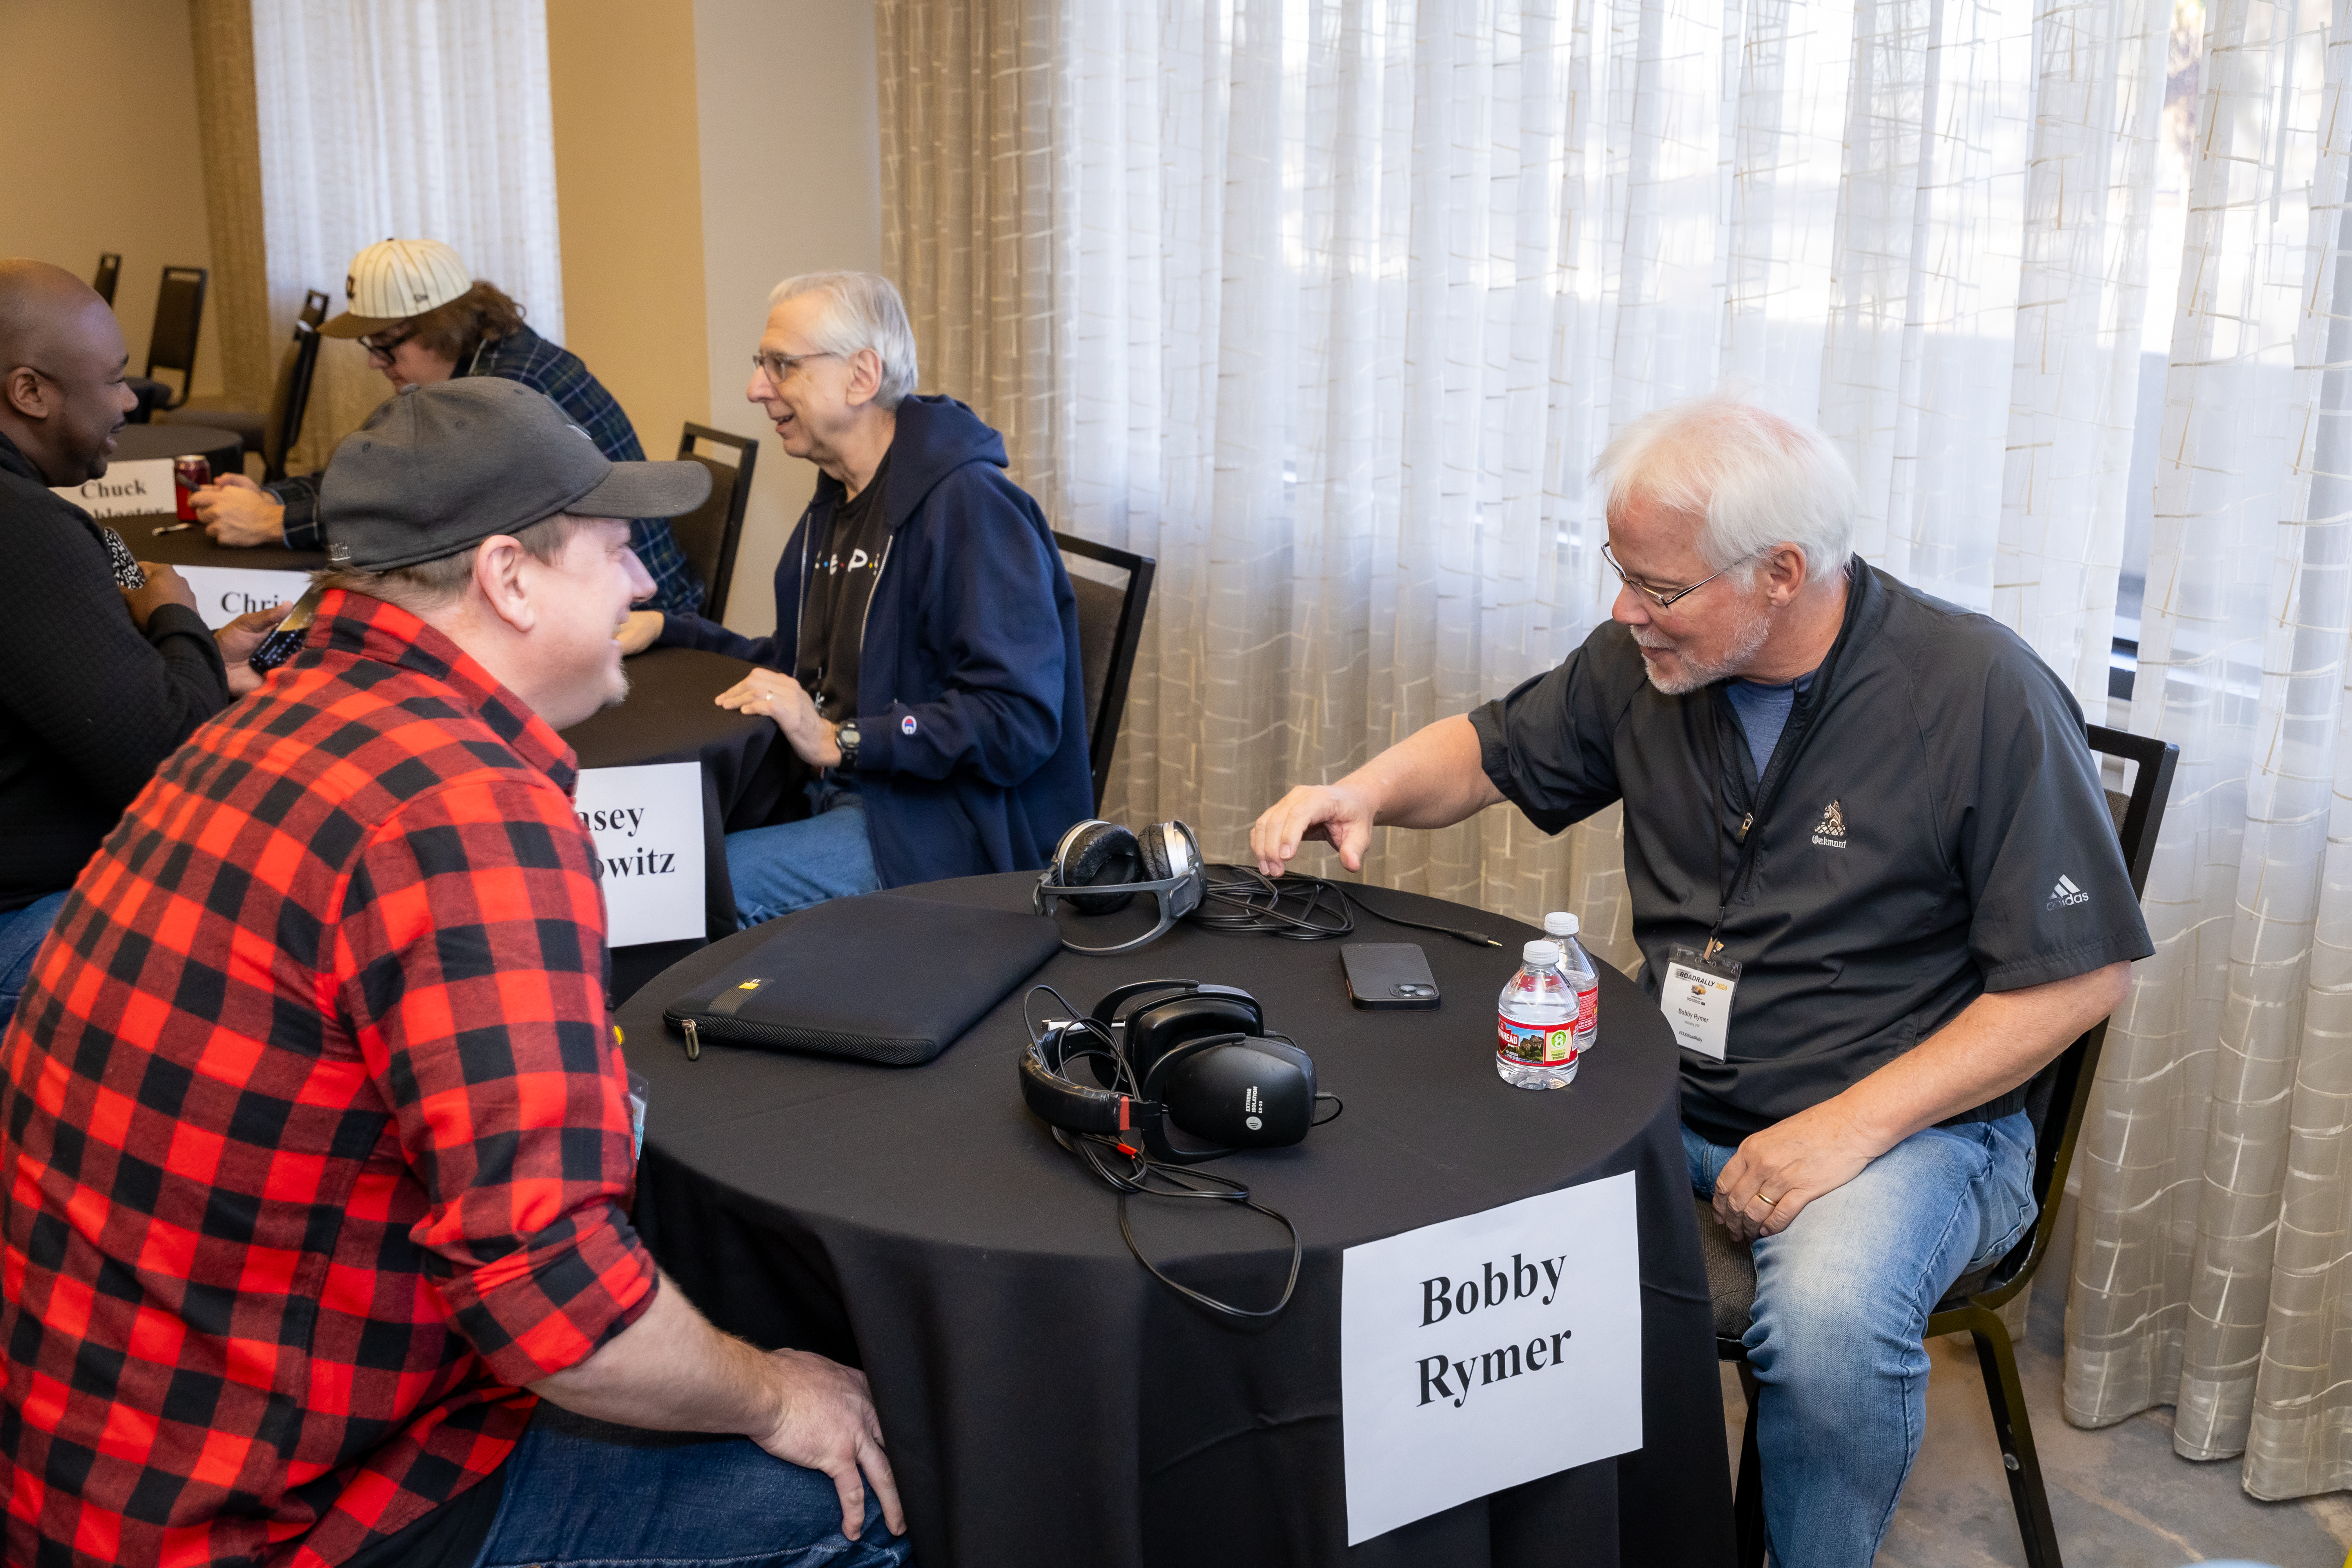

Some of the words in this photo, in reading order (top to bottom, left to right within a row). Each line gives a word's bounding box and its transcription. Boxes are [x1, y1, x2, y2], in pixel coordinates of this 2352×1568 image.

[80, 478, 146, 499] Chuck
[220, 591, 279, 614] Chri
[577, 808, 645, 837] asey
[1812, 835, 1847, 849] Oakmont
[595, 847, 675, 878] owitz
[2046, 892, 2089, 911] adidas
[1679, 971, 1716, 987] ROADRALLY
[1715, 982, 1728, 991] 2024
[1678, 1008, 1693, 1019] Bobby
[1693, 1013, 1709, 1023] Rymer
[1418, 1253, 1567, 1328] Bobby
[1415, 1330, 1572, 1408] Rymer
